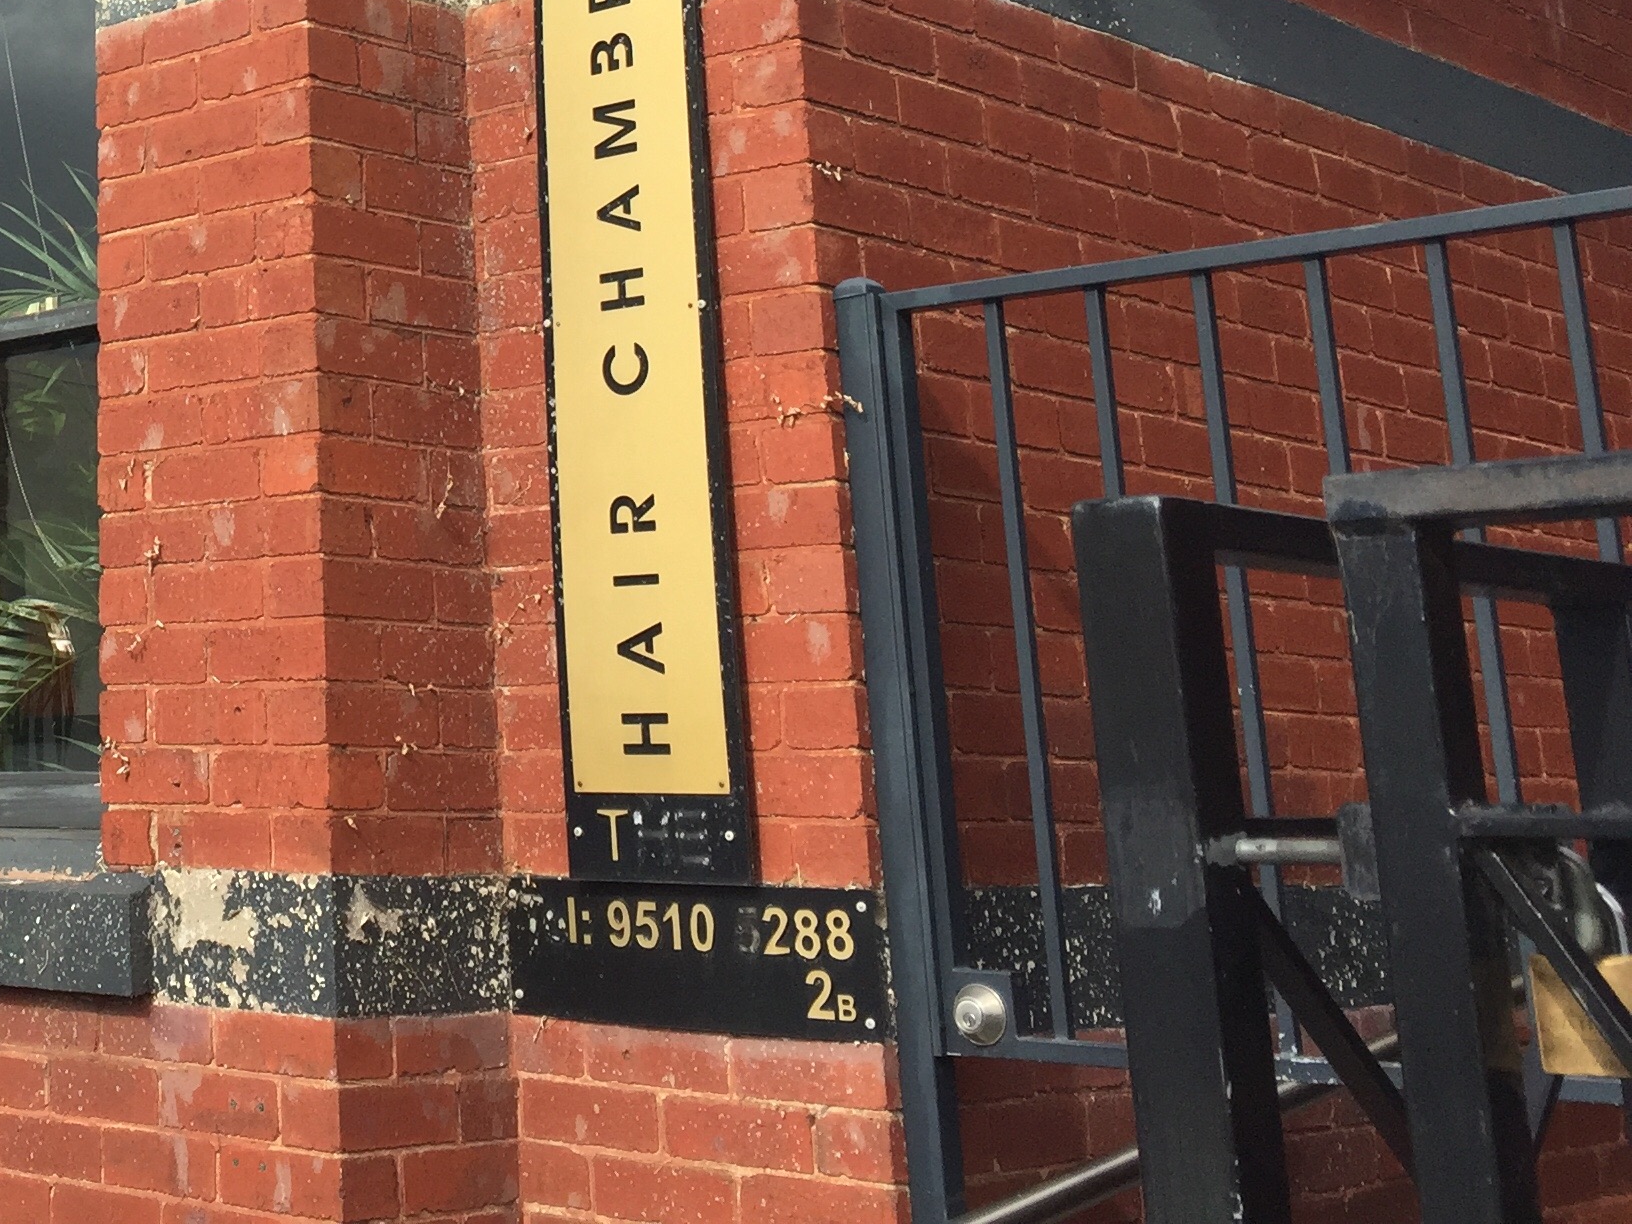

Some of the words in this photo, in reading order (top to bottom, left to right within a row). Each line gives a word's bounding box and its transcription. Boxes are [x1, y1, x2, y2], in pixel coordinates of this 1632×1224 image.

[610, 494, 671, 755] HAIR
[607, 899, 714, 952] 9510
[805, 969, 857, 1022] 2B
